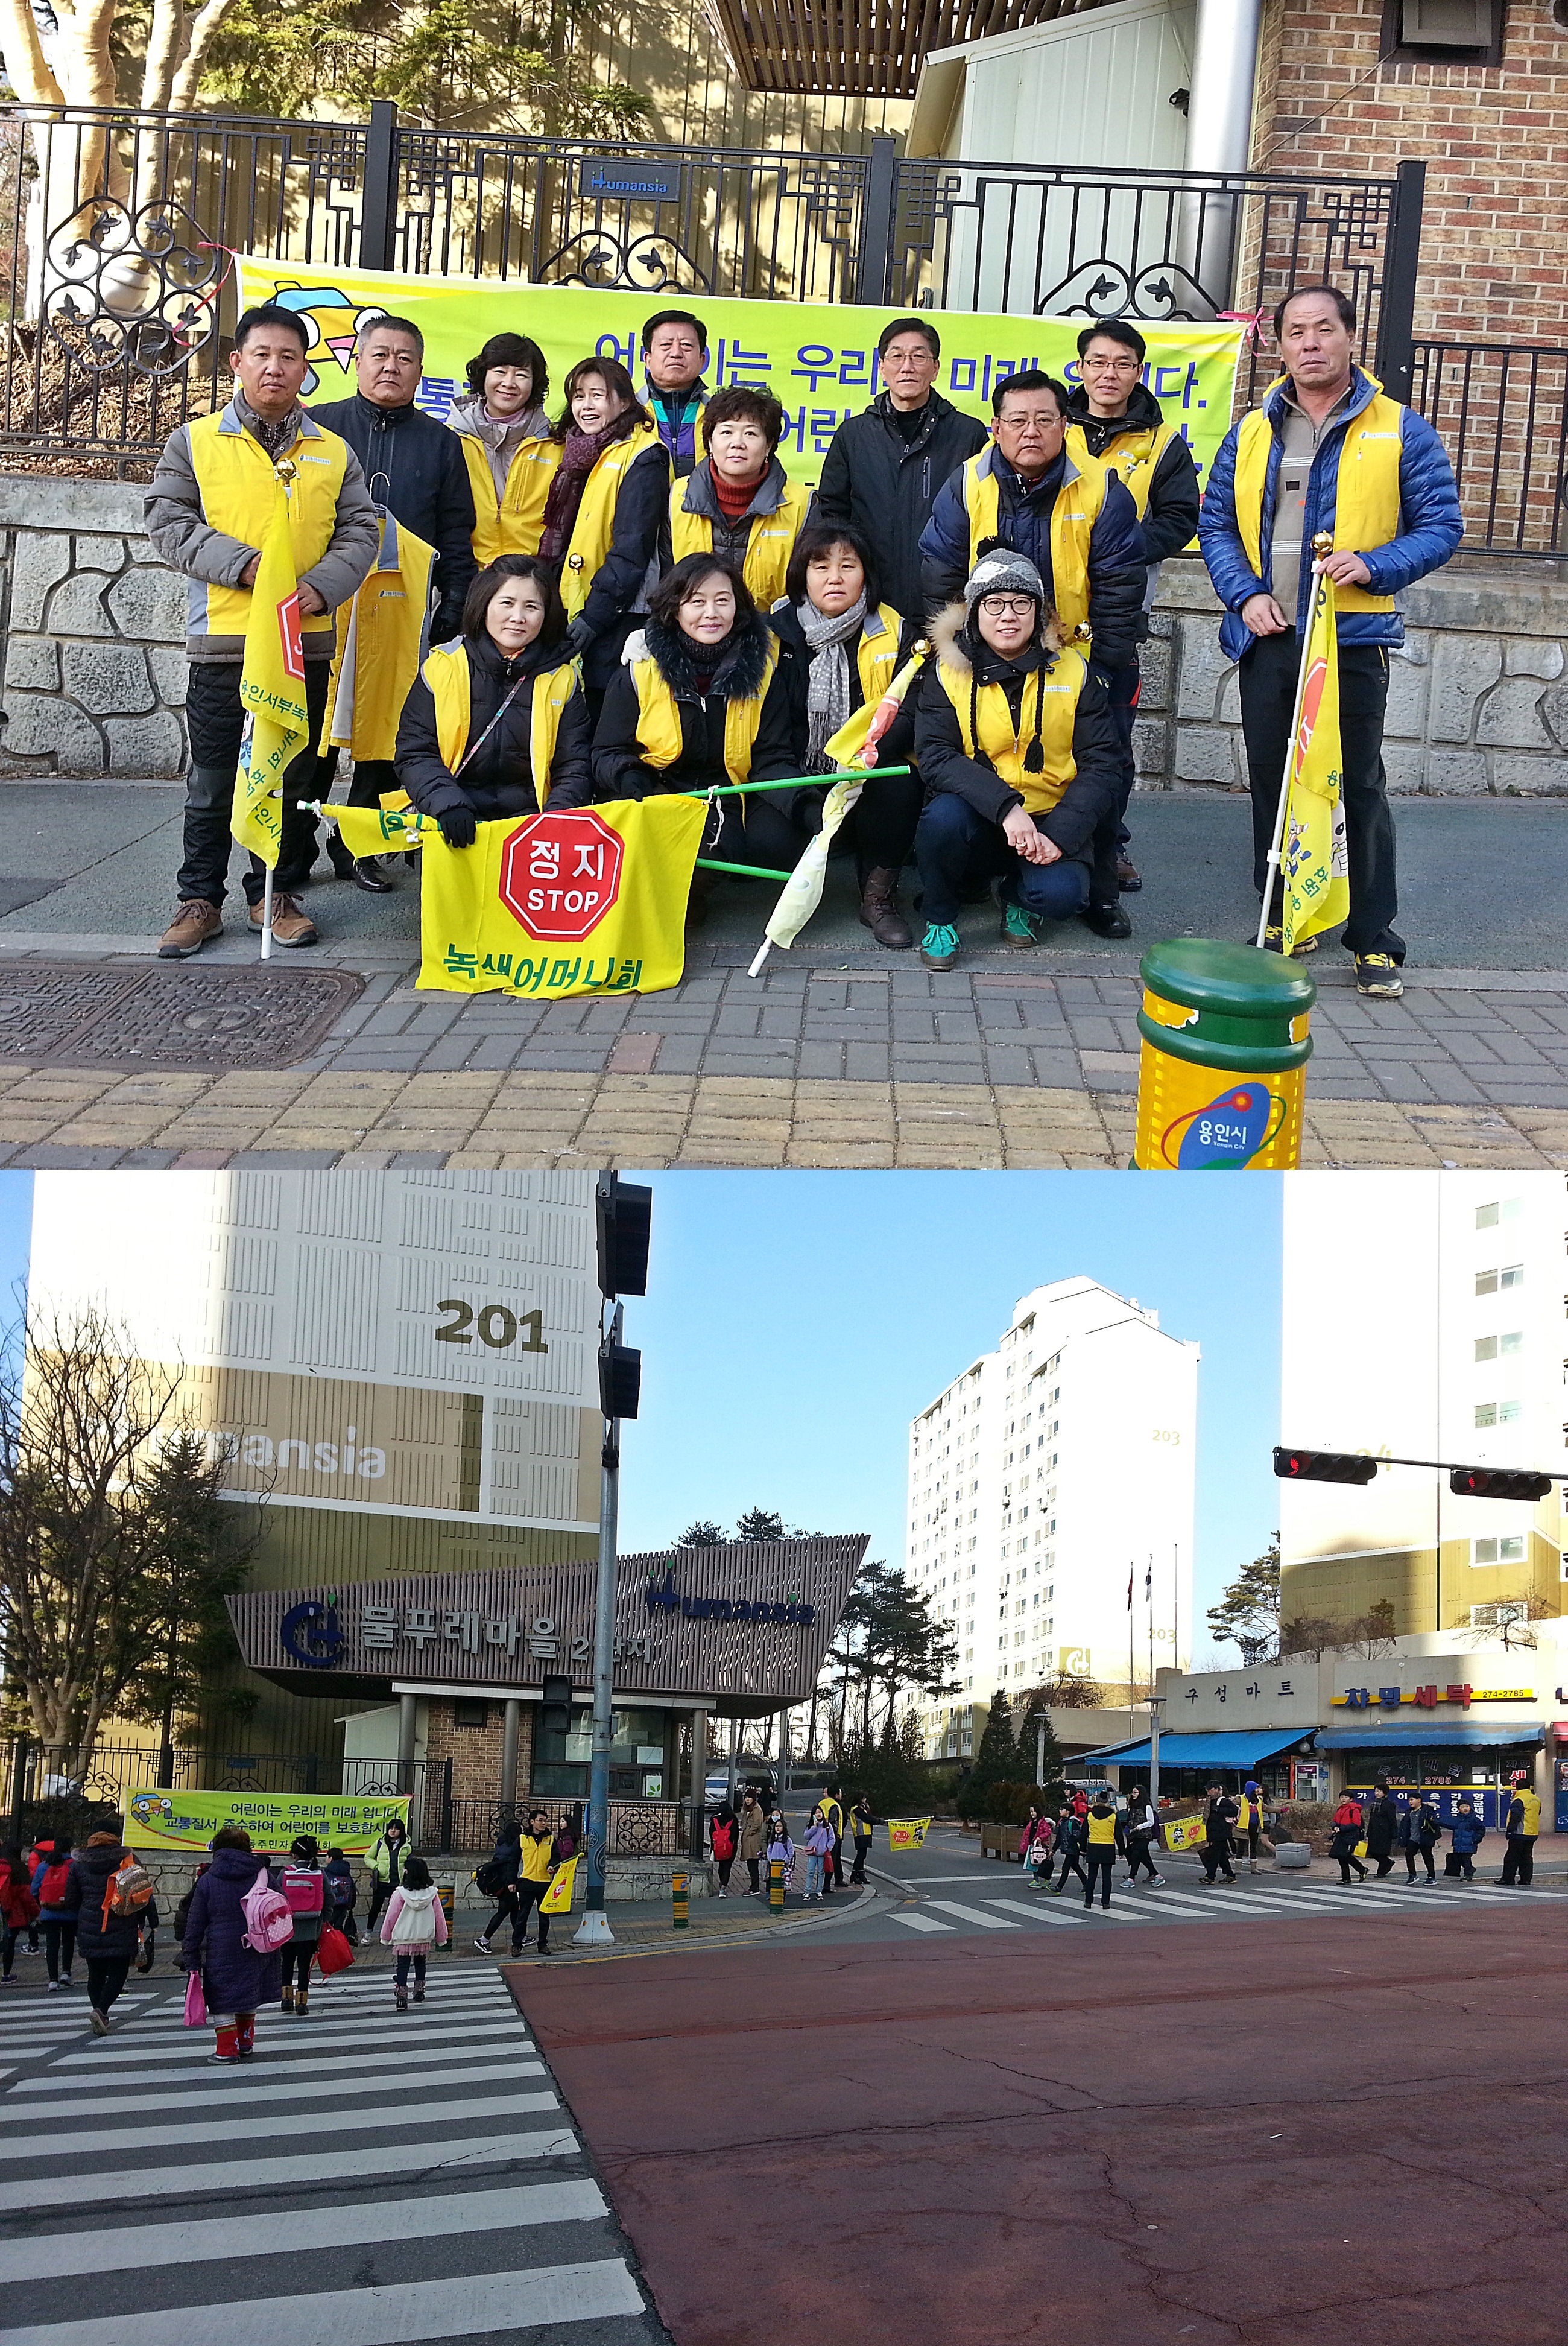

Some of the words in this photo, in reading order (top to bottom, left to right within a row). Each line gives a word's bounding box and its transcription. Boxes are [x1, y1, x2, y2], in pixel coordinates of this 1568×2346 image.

[591, 166, 668, 194] Humansia
[595, 332, 771, 387] 어이는
[791, 344, 888, 395] 우리
[779, 405, 852, 453] 어린
[241, 680, 309, 721] 용인서부녹
[527, 889, 599, 913] STOP
[443, 943, 643, 992] 녹색어머니회
[1199, 1120, 1247, 1145] 용인시
[435, 1299, 549, 1354] 201
[1152, 1430, 1180, 1445] 203
[646, 1558, 814, 1625] Humansia
[362, 1605, 561, 1659] 물푸레마을
[1148, 1628, 1176, 1644] 203
[1184, 1681, 1294, 1704] 구성마트
[1482, 1690, 1525, 1699] 274-2785
[1386, 1776, 1405, 1784] 274
[1425, 1776, 1452, 1784] 2785
[231, 1802, 282, 1817] 어린이는
[288, 1804, 326, 1818] 우리의
[332, 1805, 356, 1819] 미래
[363, 1805, 402, 1819] 입니다.
[165, 1816, 217, 1831] 교통질서
[280, 1821, 331, 1834] 어린이를
[336, 1821, 389, 1834] 보호합시
